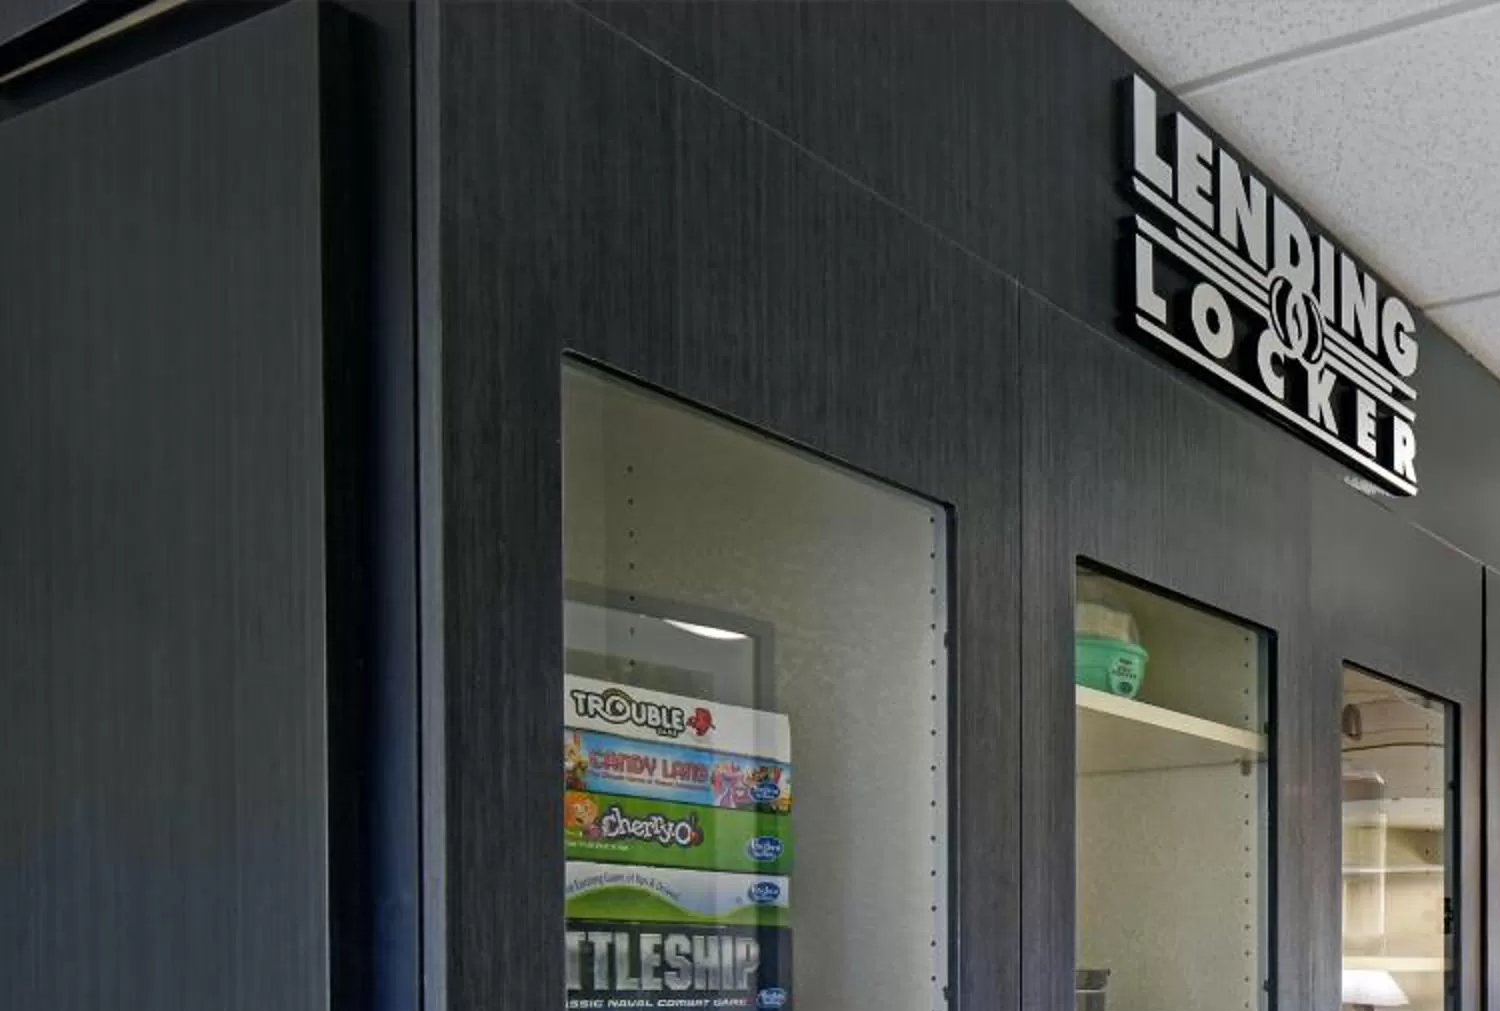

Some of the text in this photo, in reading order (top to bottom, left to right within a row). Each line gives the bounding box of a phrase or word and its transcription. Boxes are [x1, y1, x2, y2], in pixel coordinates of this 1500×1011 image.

[1132, 73, 1419, 377] LENDING
[1135, 233, 1418, 483] LOCKER
[570, 688, 685, 732] TROUBLE
[607, 999, 653, 1008] NAVAL
